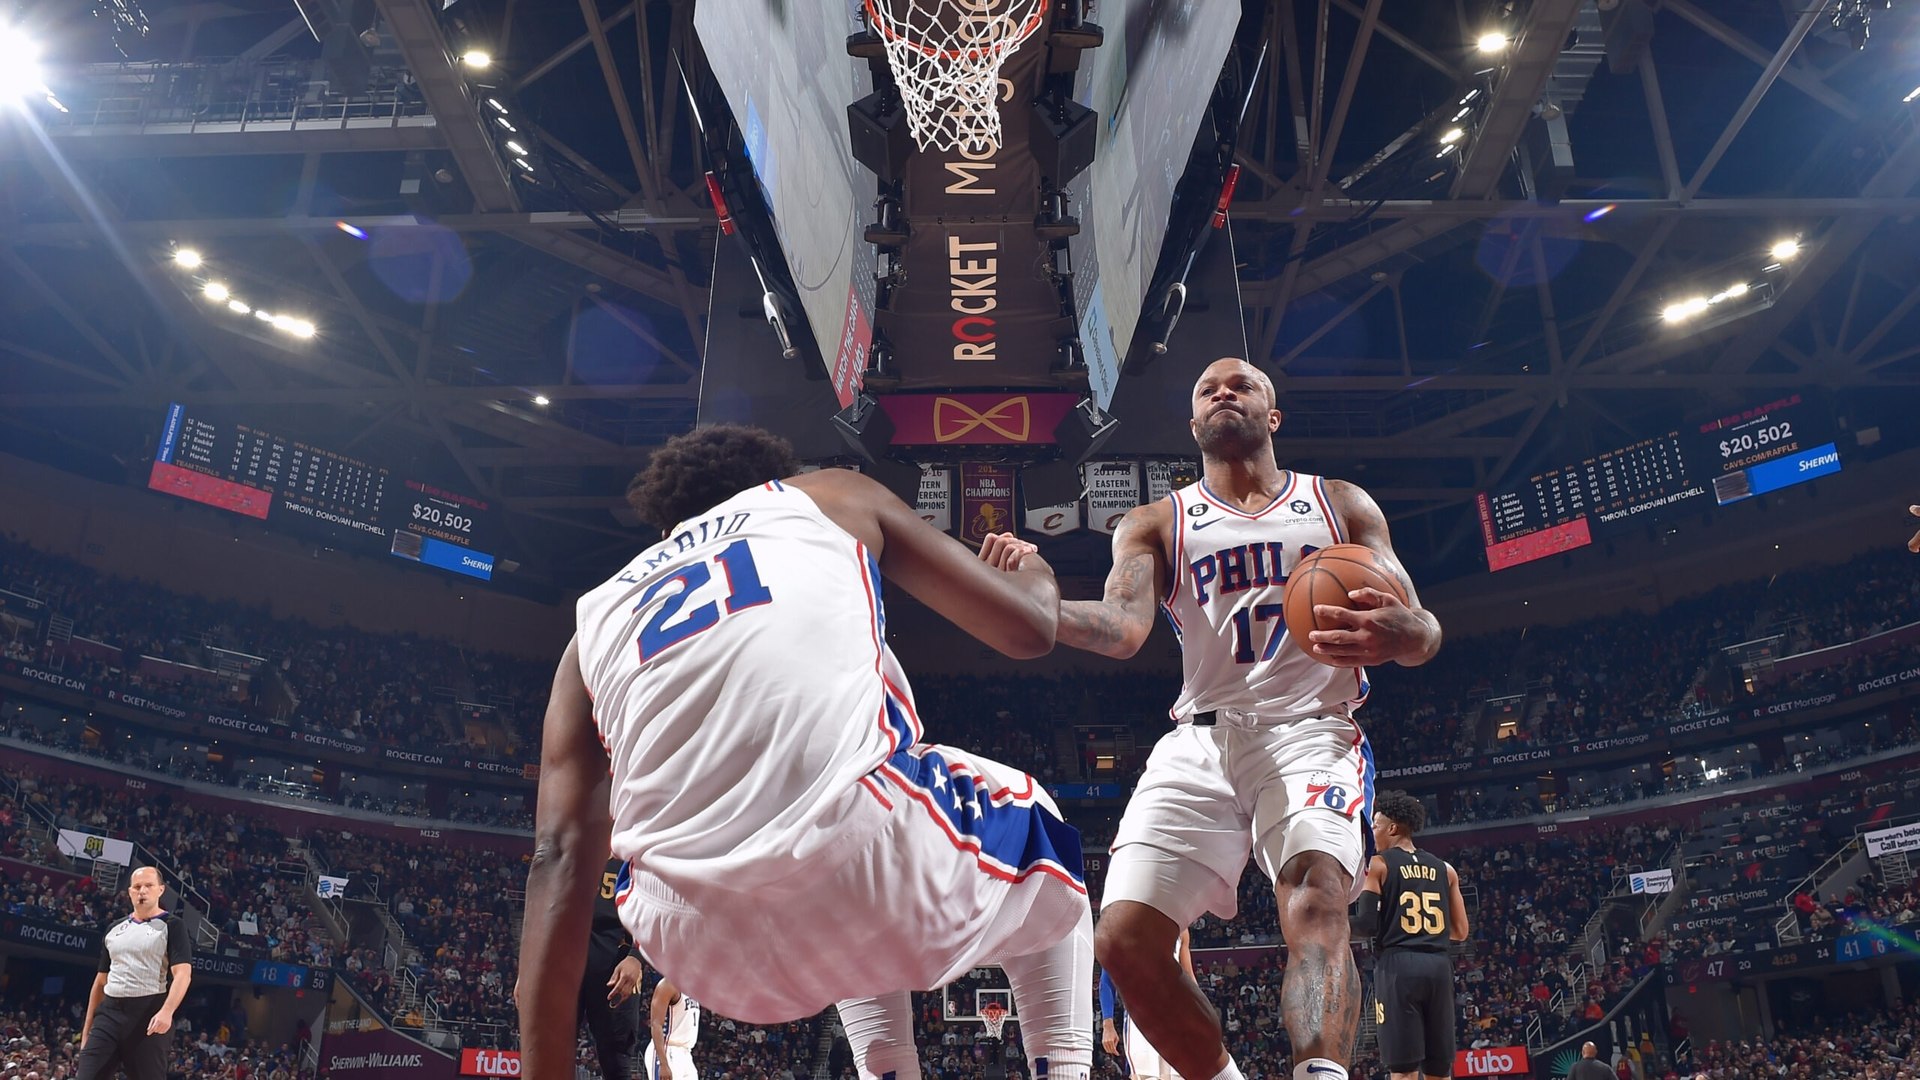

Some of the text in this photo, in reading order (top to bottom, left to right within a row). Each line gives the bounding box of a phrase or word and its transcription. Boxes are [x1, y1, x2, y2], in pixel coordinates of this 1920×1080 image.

[948, 235, 998, 362] ROCKET
[196, 429, 215, 439] Tucker
[197, 421, 215, 431] Harris
[1719, 422, 1793, 458] $20,502
[190, 453, 210, 463] Harden
[1723, 442, 1798, 471] CAVS.COM/RAFFLE
[1799, 451, 1839, 472] SHERWI
[979, 478, 996, 488] NBA
[1095, 479, 1131, 488] EASTERN
[965, 487, 1011, 497] CHAMPIONS
[1089, 489, 1138, 499] CONFERENCE
[1630, 498, 1666, 514] DONOVAN
[1667, 486, 1705, 503] MITCHELL
[1091, 500, 1136, 509] CHAMPIONS
[316, 510, 350, 526] DONOVAN
[352, 521, 386, 536] MITCHELL
[412, 503, 472, 532] $20,502
[1285, 515, 1324, 524] crypto.com
[461, 555, 493, 572] SHERWI
[631, 538, 773, 666] 21
[1232, 603, 1290, 664] 17
[22, 666, 87, 691] ROCKET CAN
[1858, 667, 1920, 693] ROCKET CAN
[146, 699, 186, 718] Mortgage
[1793, 692, 1837, 709] Mortgage
[208, 715, 269, 734] ROCKET CAN
[1670, 715, 1730, 735] ROCKET CAN
[327, 739, 366, 754] Mortgage
[1609, 733, 1649, 747] Mortgage
[386, 749, 443, 765] ROCKET CAN
[1492, 749, 1551, 765] ROCKET CAN
[1402, 762, 1448, 776] KNOW.
[1452, 761, 1473, 772] gage
[1086, 786, 1100, 797] 41
[1303, 783, 1346, 810] 76
[420, 829, 440, 838] M125
[1537, 824, 1558, 833] M103
[86, 836, 105, 852] 811
[1880, 840, 1897, 851] Call
[1399, 863, 1437, 882] OKORO
[600, 871, 618, 900] 5
[1736, 888, 1768, 901] Homes
[1399, 890, 1446, 936] 35
[19, 924, 88, 949] ROCKET CAN
[1816, 948, 1829, 958] 24
[1844, 940, 1861, 957] 41
[261, 967, 278, 982] 18
[1707, 960, 1724, 977] 47
[312, 977, 325, 989] 50
[475, 1050, 521, 1075] fubo
[1465, 1050, 1514, 1074] fubo
